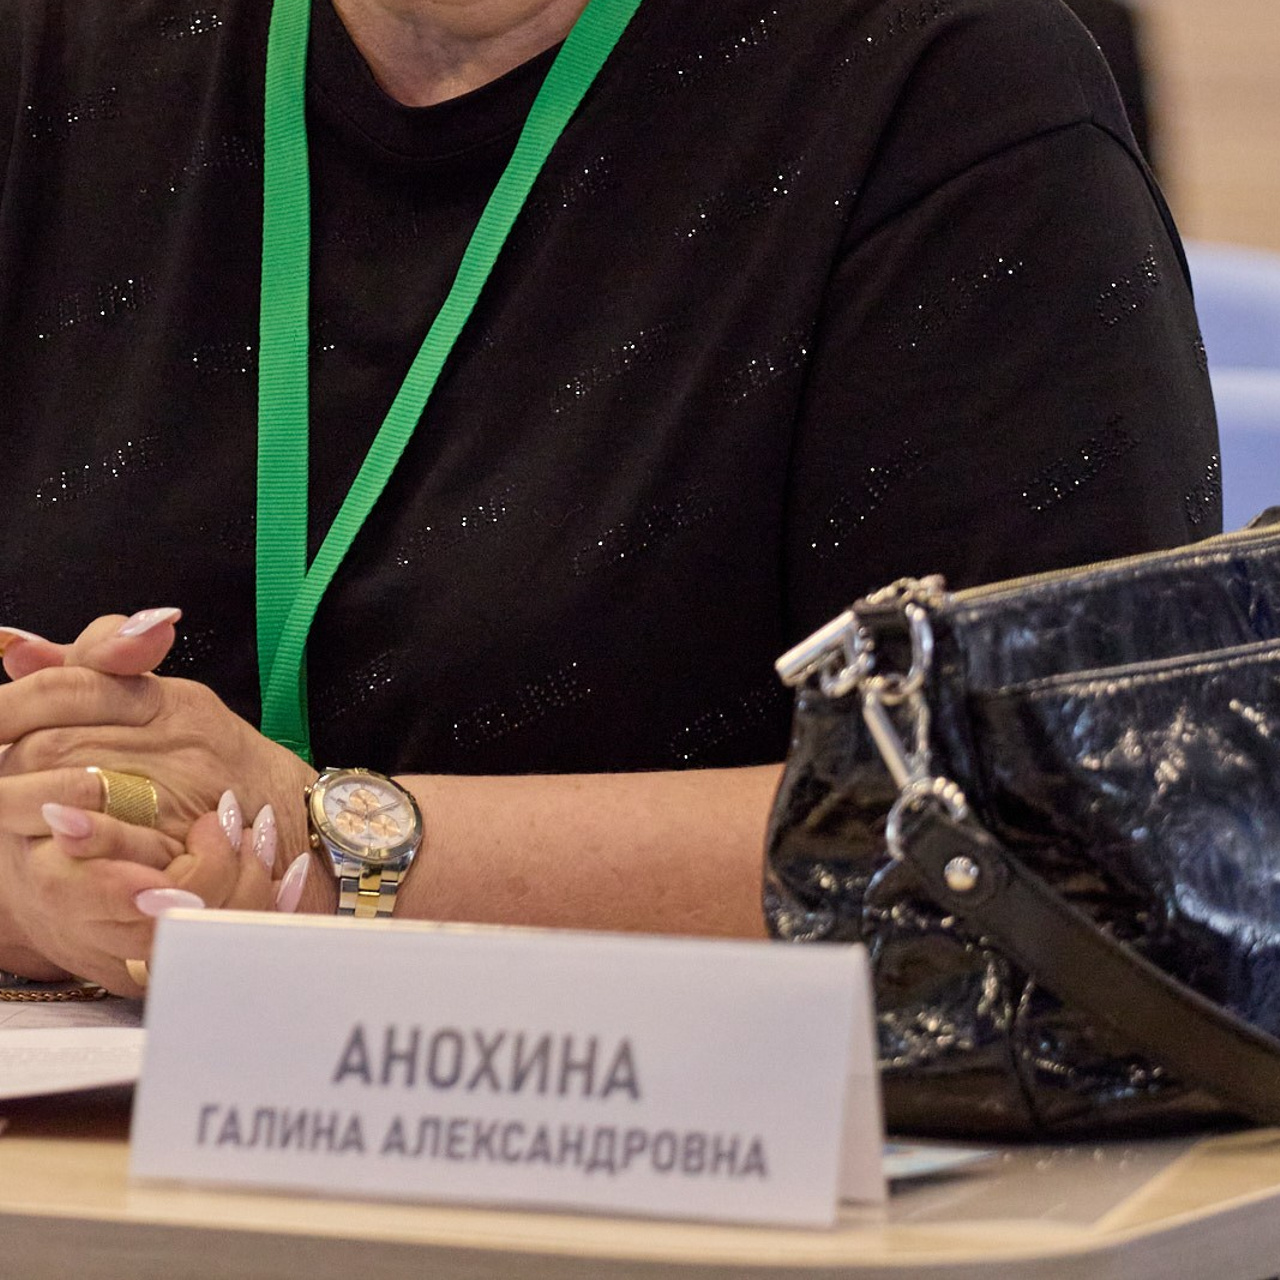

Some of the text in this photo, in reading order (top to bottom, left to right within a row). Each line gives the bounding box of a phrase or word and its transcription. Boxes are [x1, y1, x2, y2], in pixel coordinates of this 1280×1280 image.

[332, 1024, 640, 1101] АНОХИНА
[196, 1105, 770, 1179] ГАЛИНА АЛЕКСАНДРОВНА
